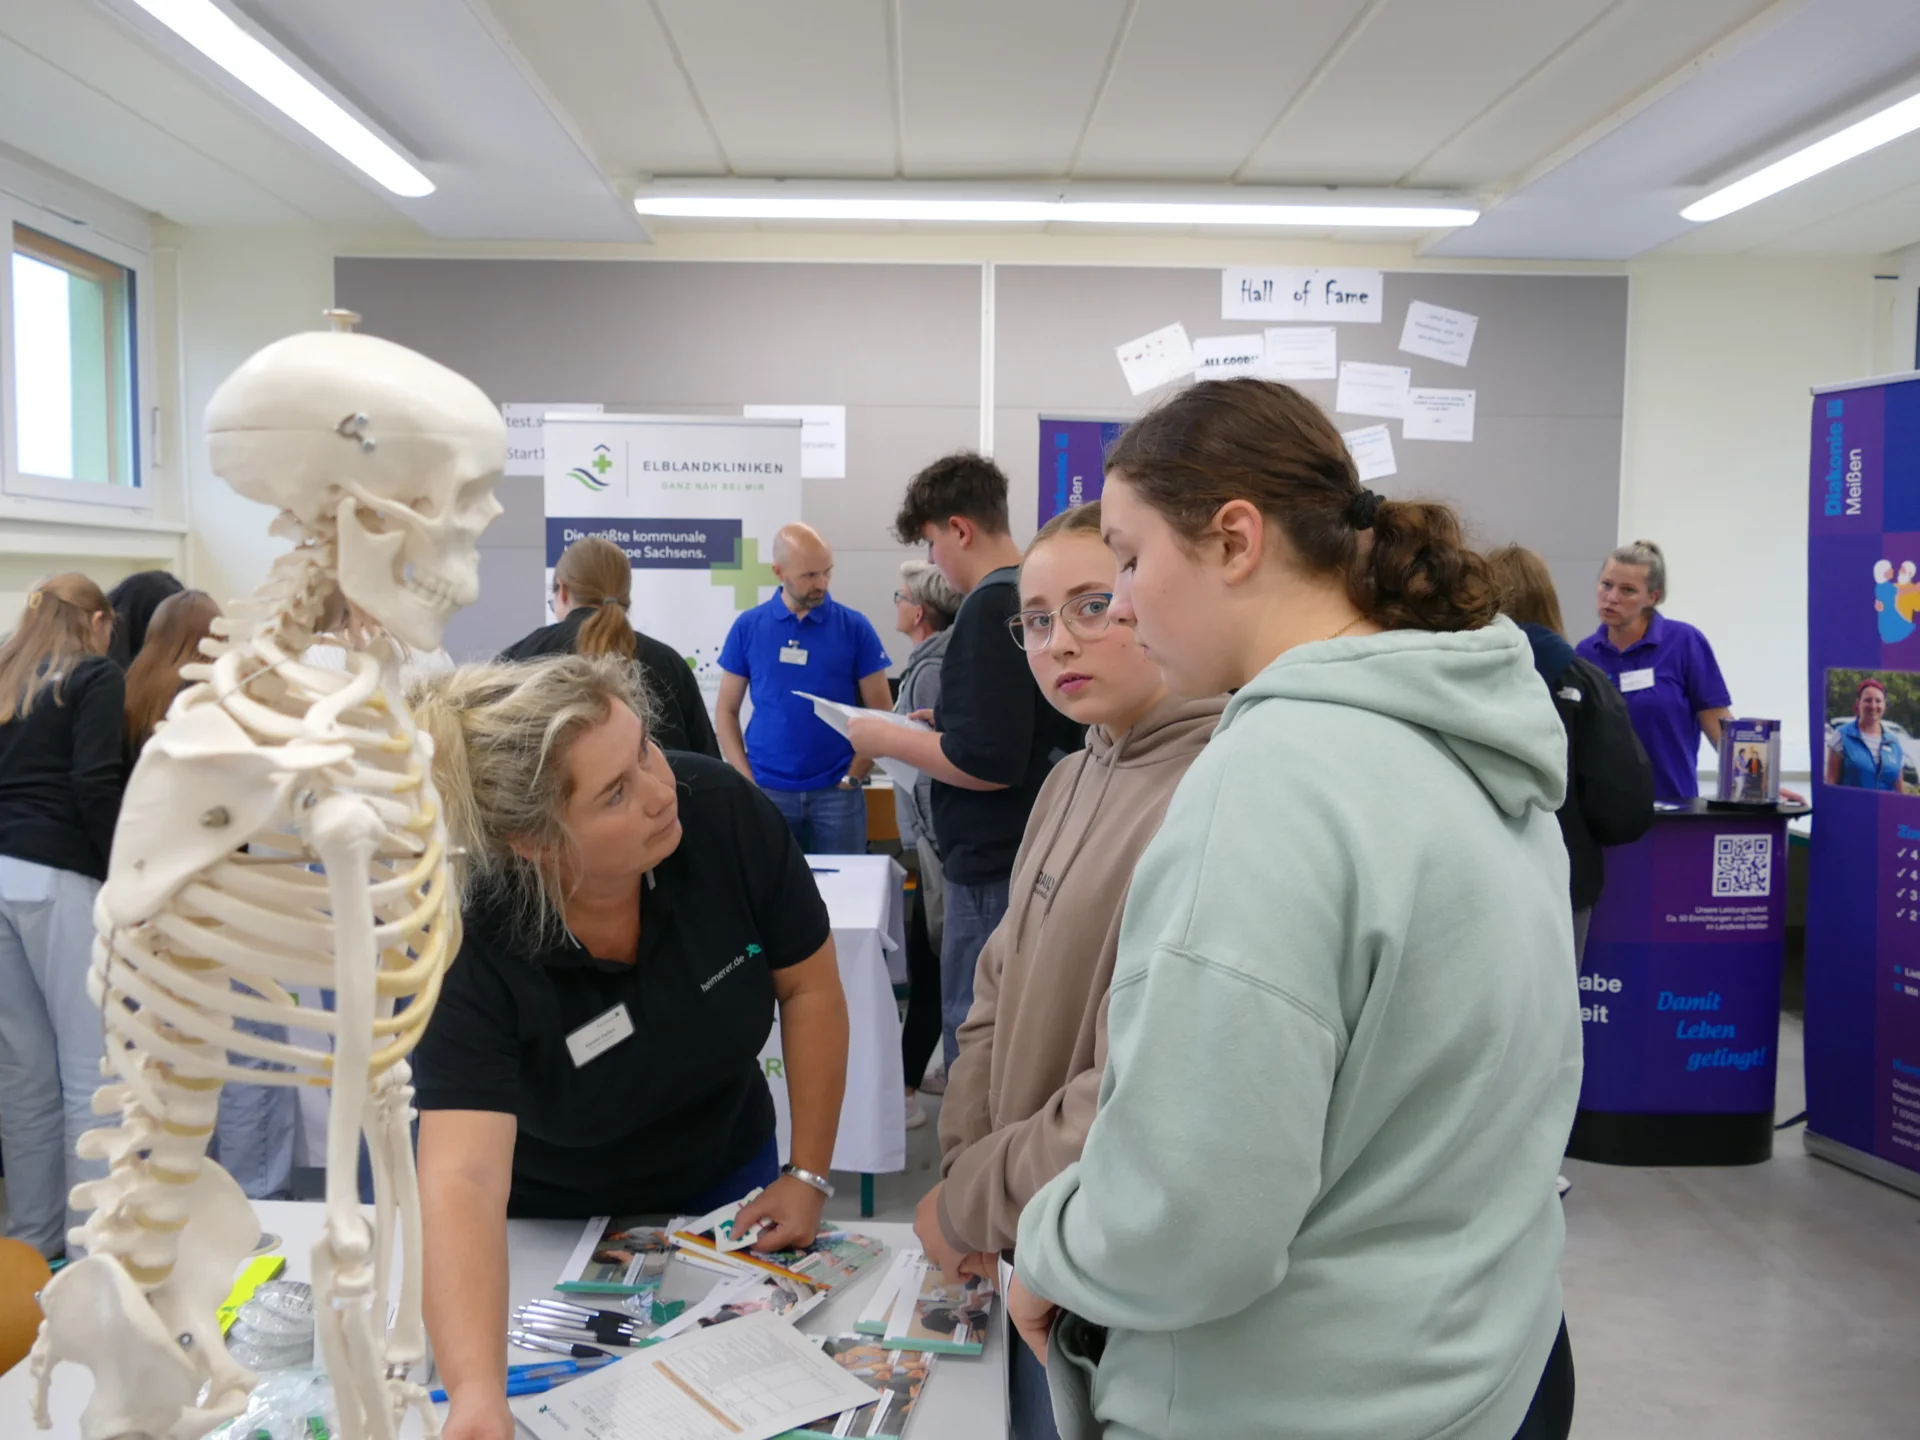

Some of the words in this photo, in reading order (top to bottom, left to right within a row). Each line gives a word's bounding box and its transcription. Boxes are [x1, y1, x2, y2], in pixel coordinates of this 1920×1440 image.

[1241, 279, 1273, 303] Hall
[1293, 279, 1310, 306] of
[1325, 279, 1368, 305] Fame
[506, 415, 545, 429] test.s
[643, 461, 784, 474] ELBLANDKLINIKEN
[1824, 422, 1844, 516] Diakonie
[661, 482, 691, 490] GANZ
[695, 482, 718, 491] NAH
[745, 483, 765, 491] MIR
[1069, 476, 1083, 507] ißen
[1846, 448, 1862, 516] Meißen
[632, 530, 707, 544] kommunale
[643, 546, 707, 560] Sachsens.
[700, 954, 745, 993] heimerer.de
[1579, 973, 1622, 993] abe
[1656, 991, 1721, 1011] Damit
[1580, 1004, 1609, 1023] eit
[1676, 1020, 1735, 1040] Leben
[1685, 1047, 1766, 1072] gelingt!
